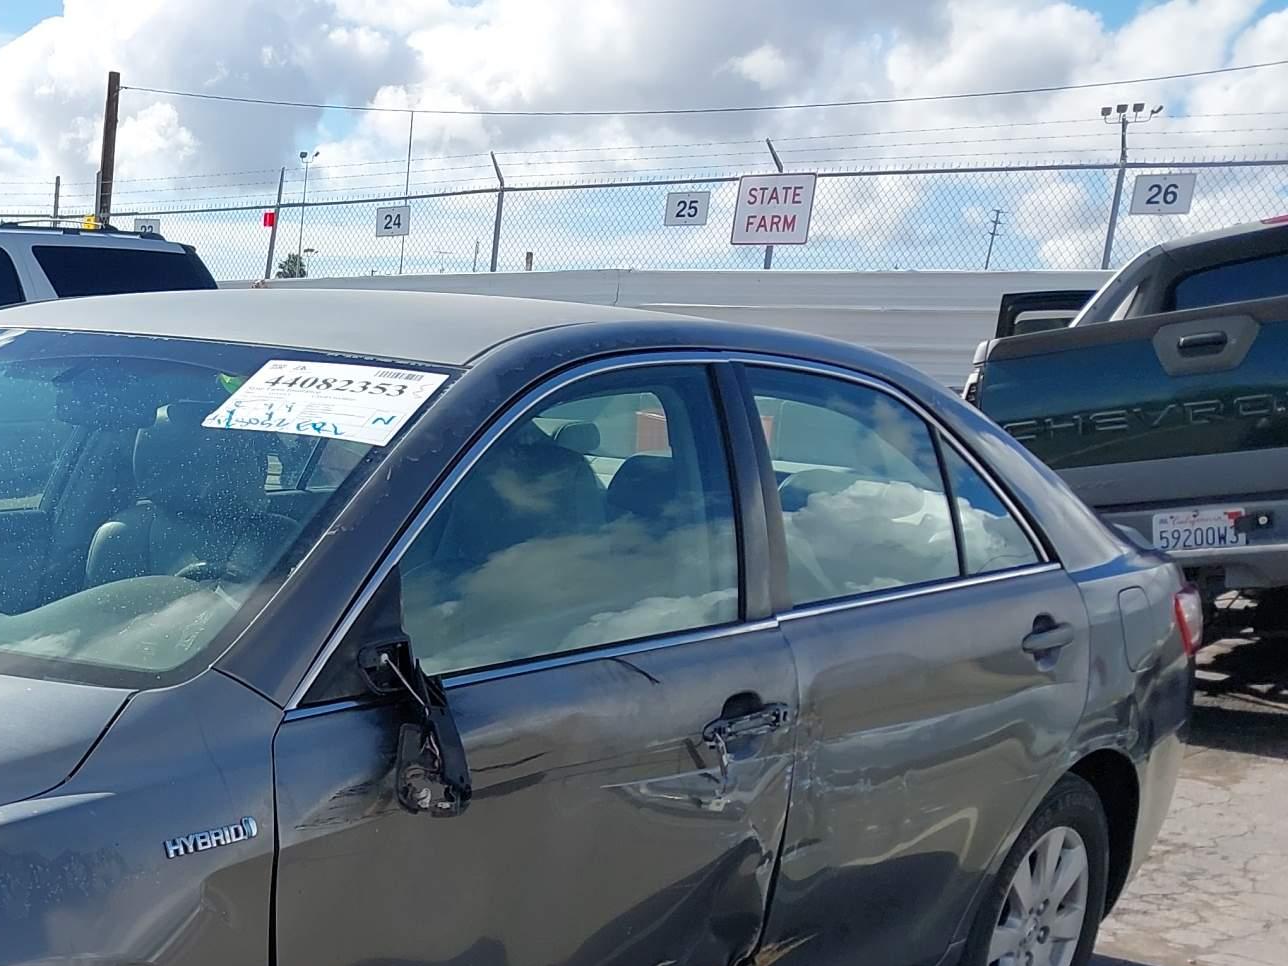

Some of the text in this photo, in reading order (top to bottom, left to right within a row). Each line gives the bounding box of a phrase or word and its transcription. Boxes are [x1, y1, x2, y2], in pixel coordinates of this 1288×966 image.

[746, 186, 804, 205] STATE
[1145, 183, 1179, 205] 26
[675, 200, 699, 218] 25
[383, 213, 402, 230] 24
[745, 215, 797, 233] FARM
[264, 374, 409, 397] 44082353
[164, 824, 247, 859] HYBRID
